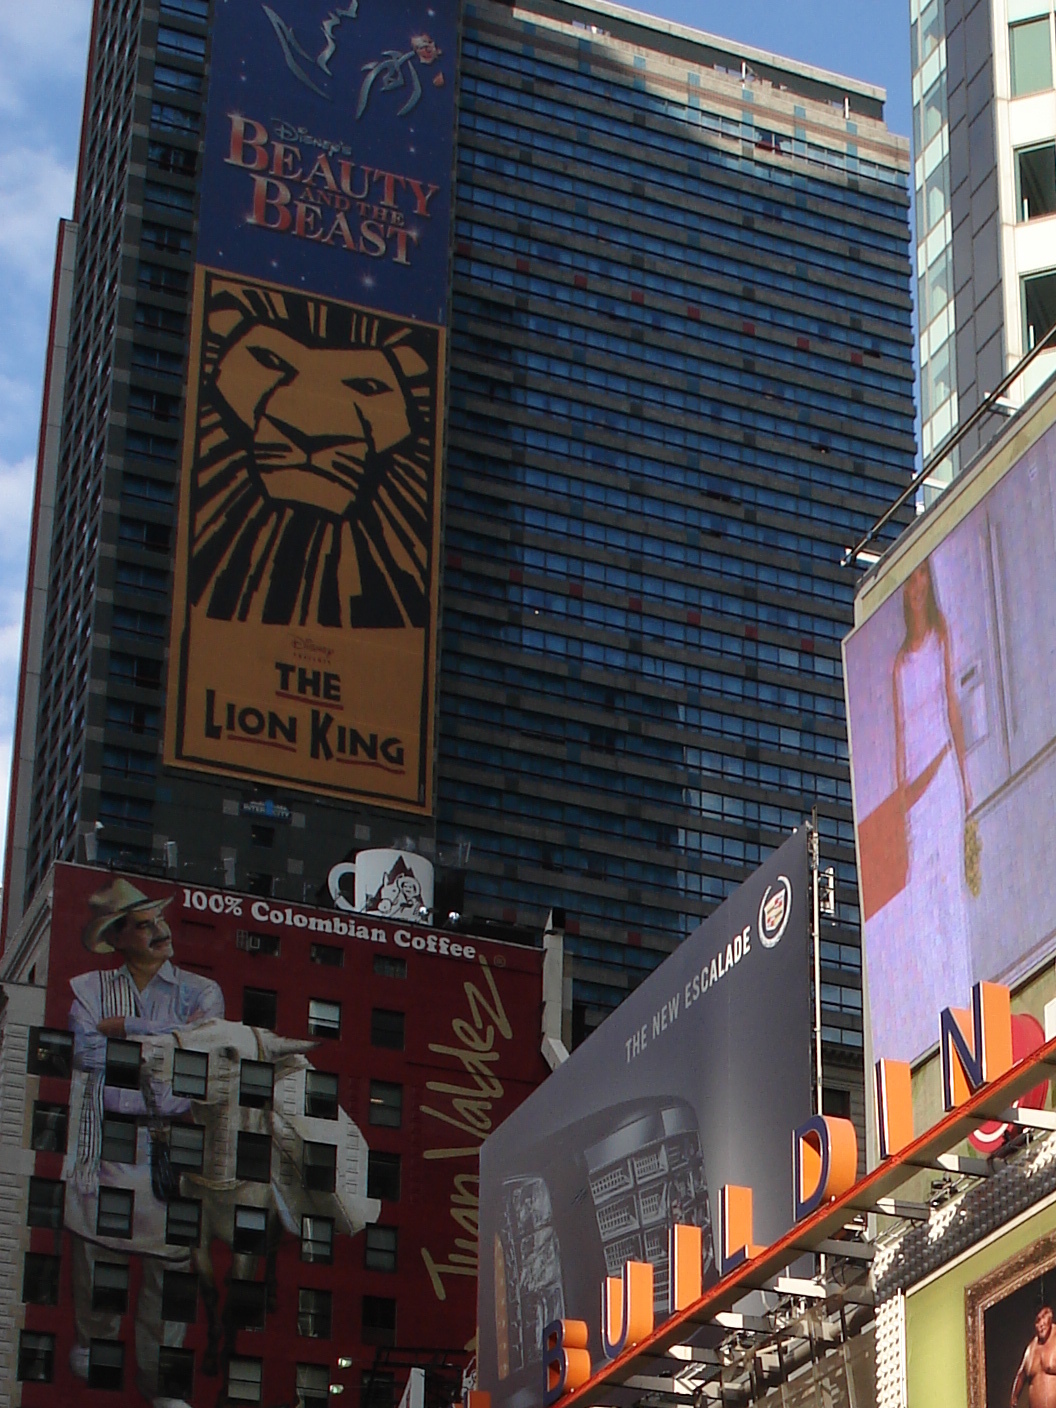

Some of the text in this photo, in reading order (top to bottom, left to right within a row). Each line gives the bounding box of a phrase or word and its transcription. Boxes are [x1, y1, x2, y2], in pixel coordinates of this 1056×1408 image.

[224, 114, 439, 217] BEAUTY
[247, 173, 418, 265] BEAST
[301, 187, 404, 226] AND THE
[275, 662, 341, 701] THE
[205, 689, 404, 767] LION KING
[182, 889, 476, 960] 100% Colombian Coffee
[625, 925, 751, 1064] THE NEW ESCALADE
